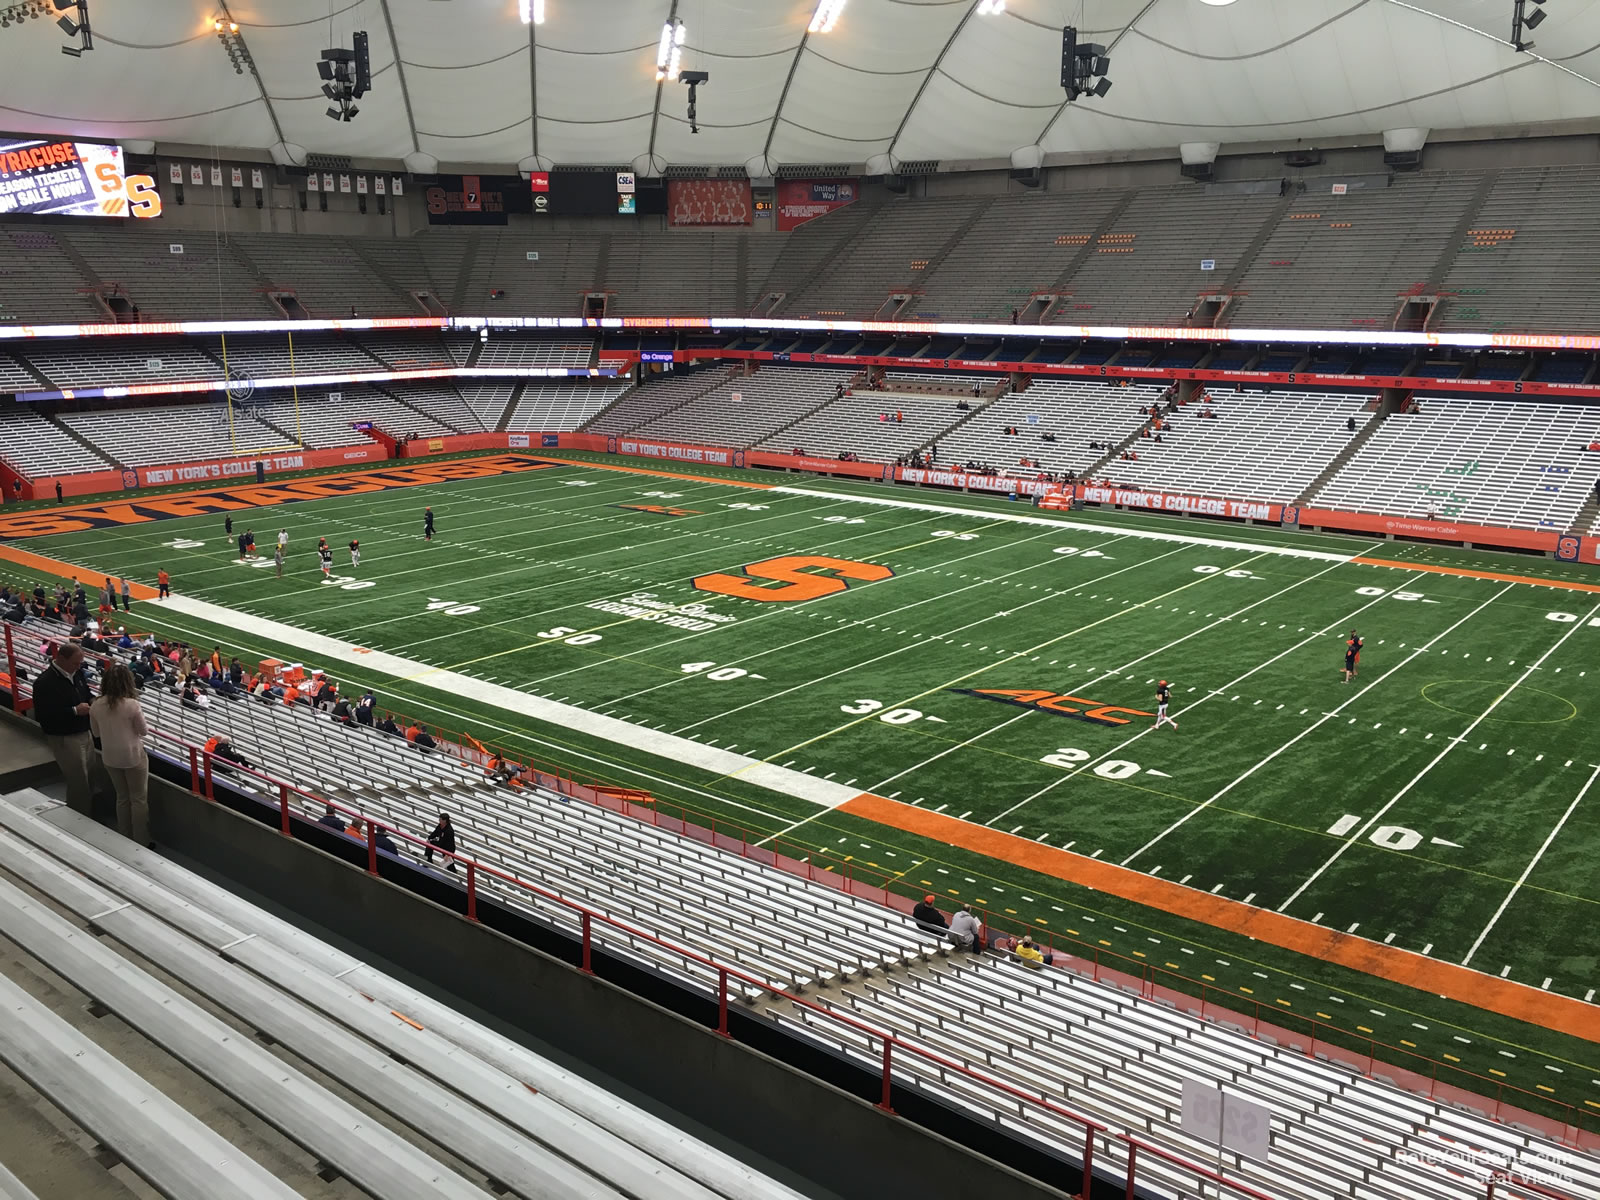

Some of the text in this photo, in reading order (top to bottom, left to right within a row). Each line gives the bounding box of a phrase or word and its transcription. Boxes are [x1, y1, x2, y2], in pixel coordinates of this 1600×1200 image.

[17, 187, 51, 206] SALE
[50, 180, 86, 199] NOW!
[468, 193, 476, 203] 7
[813, 185, 836, 193] United
[821, 192, 836, 200] Way
[624, 318, 667, 327] SYRACUSE
[669, 318, 710, 327] FOOTBALL
[1492, 335, 1561, 348] SYRACUSE
[621, 442, 728, 463] NEW YORK'S COLLEGE TEAM
[146, 455, 304, 484] NEW YORK'S COLLEE TEAM
[901, 468, 924, 483] NEW
[927, 471, 966, 488] YORK'S
[968, 475, 1017, 492] COLLEGE
[0, 454, 553, 538] SYRACUSE
[1084, 487, 1112, 503] NEW
[1115, 490, 1162, 508] YORK'S
[1165, 495, 1226, 514] COLLEGE
[1230, 502, 1270, 520] TEAM
[1283, 506, 1297, 524] S
[1395, 522, 1457, 534] Time Warner Cable
[1560, 537, 1579, 560] S
[426, 601, 481, 616] 40
[584, 600, 717, 631] LEGENDS FIELD
[537, 626, 603, 645] 50
[681, 661, 748, 681] 40
[360, 698, 372, 707] 14
[840, 699, 923, 724] 30
[971, 688, 1158, 725] ACC
[1039, 748, 1142, 780] 20
[1326, 813, 1424, 851] 10
